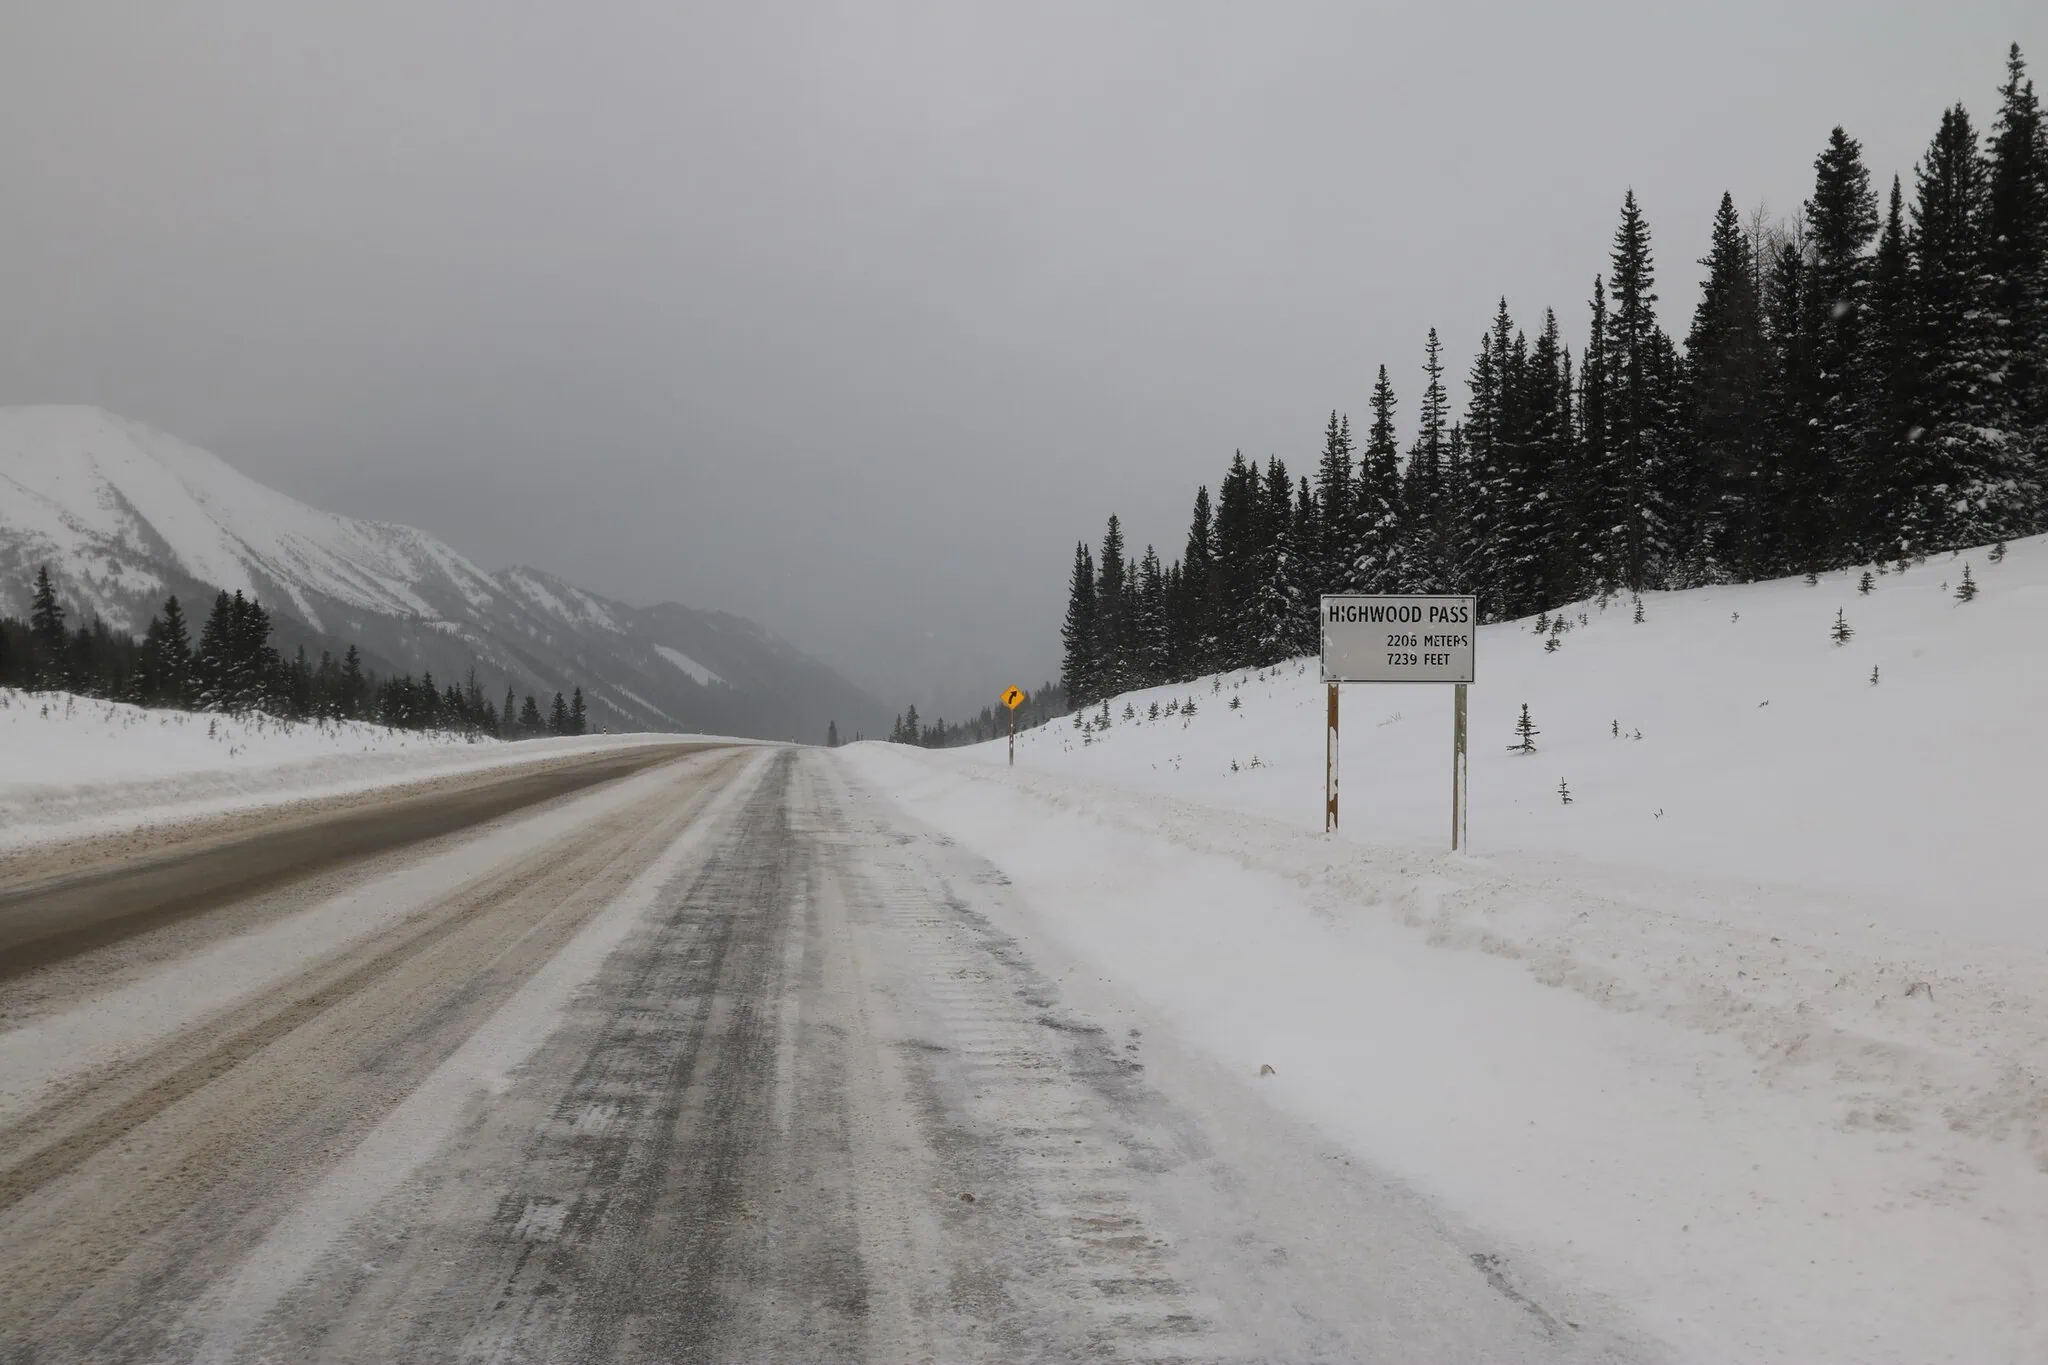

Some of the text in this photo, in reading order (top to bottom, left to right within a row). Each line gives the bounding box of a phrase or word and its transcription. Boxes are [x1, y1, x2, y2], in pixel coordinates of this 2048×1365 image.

[1329, 605, 1468, 623] HIGHWOOD PASS
[1386, 634, 1468, 647] 2206 METERS
[1387, 653, 1450, 666] 7239 FEET
